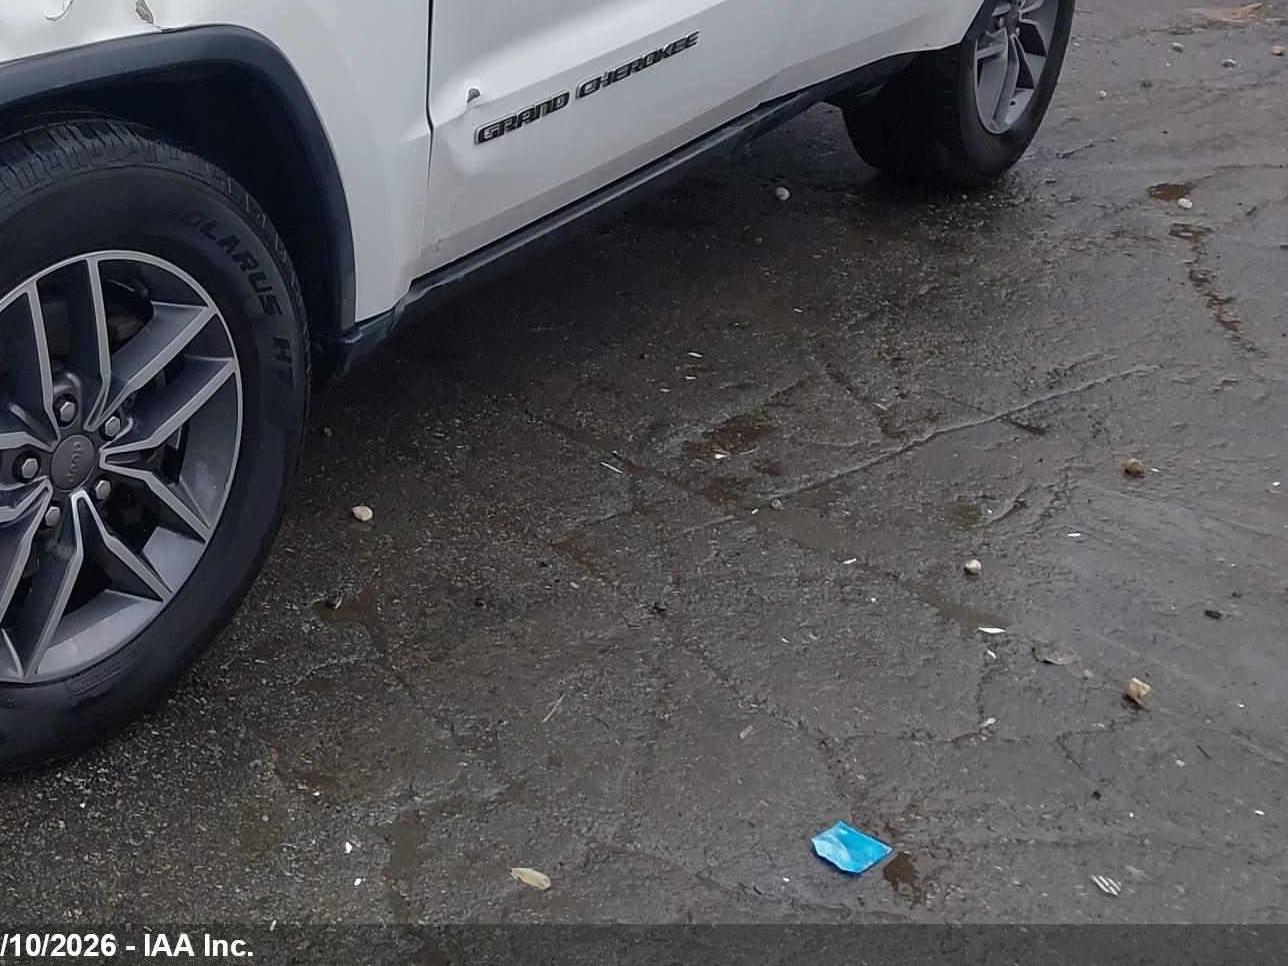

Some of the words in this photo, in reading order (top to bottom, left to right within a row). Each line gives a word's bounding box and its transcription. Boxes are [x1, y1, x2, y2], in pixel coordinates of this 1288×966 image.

[474, 89, 570, 145] GRAND
[575, 30, 700, 99] CHEROKEE
[162, 208, 283, 317] OLARUS
